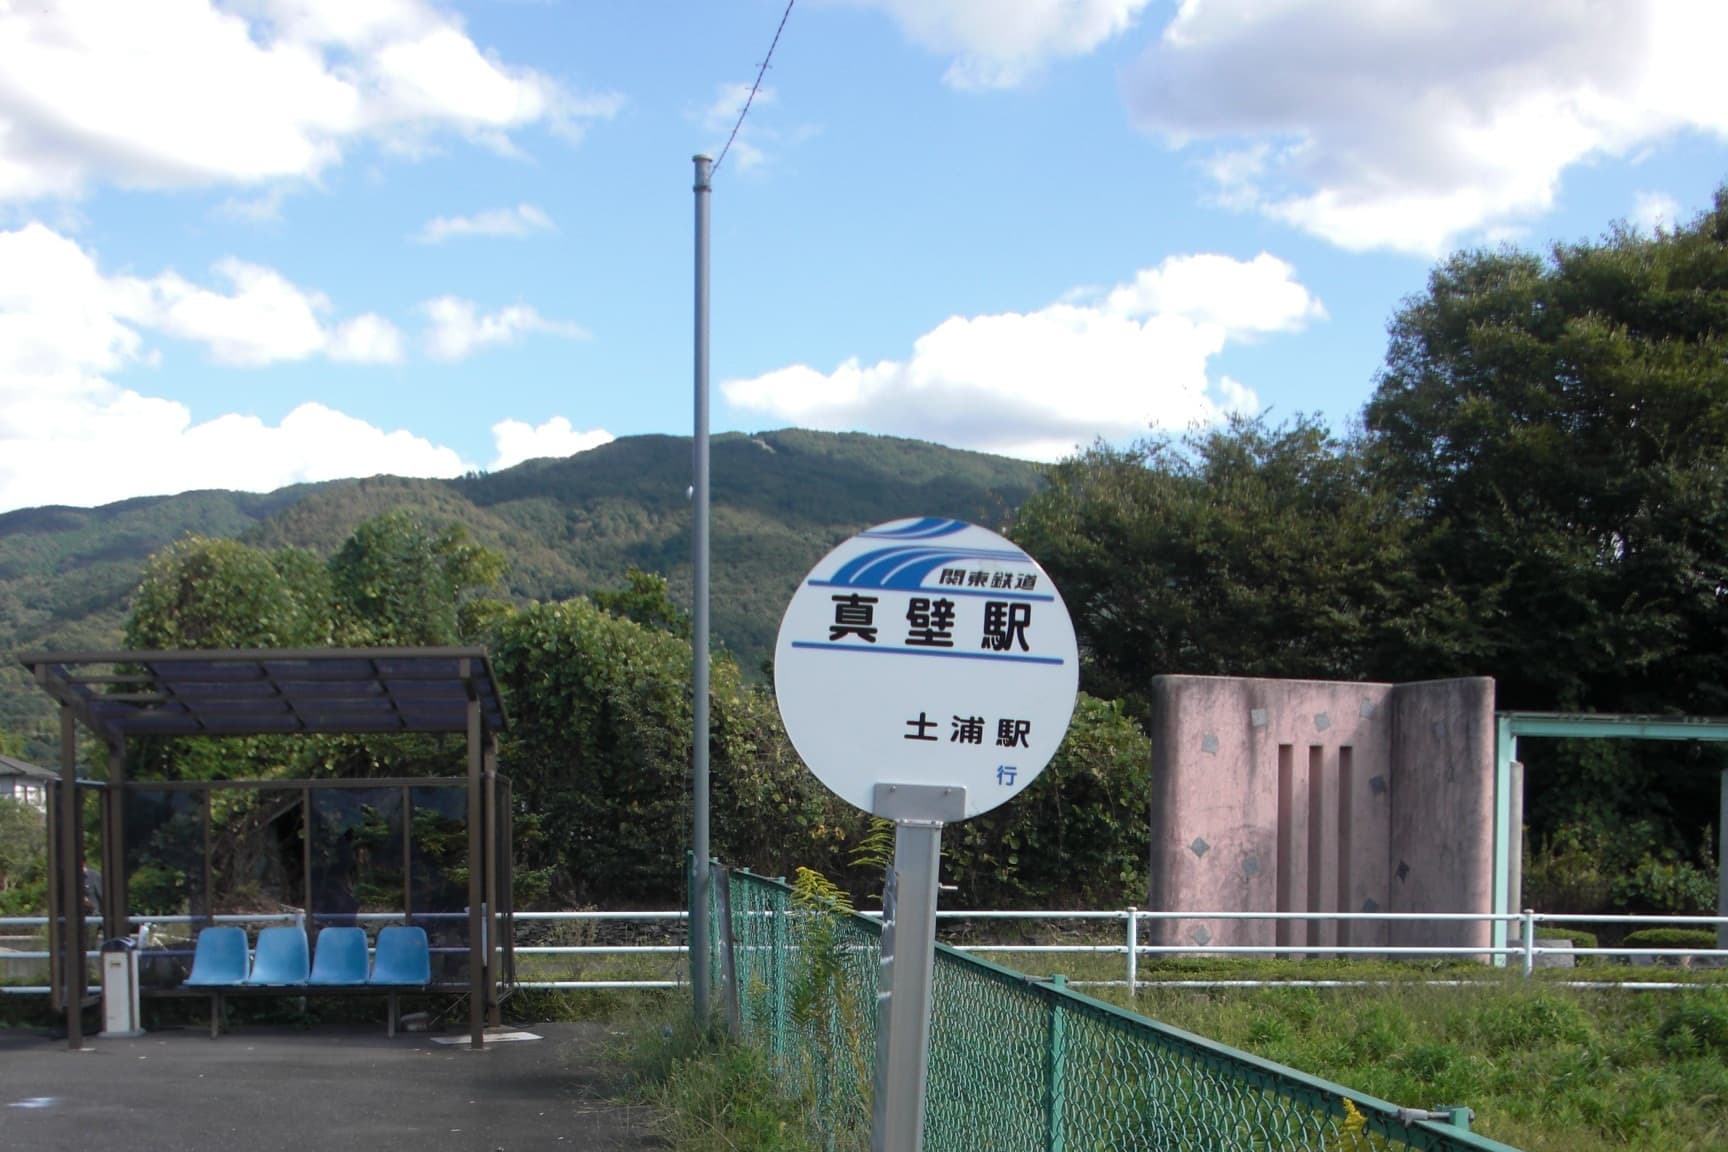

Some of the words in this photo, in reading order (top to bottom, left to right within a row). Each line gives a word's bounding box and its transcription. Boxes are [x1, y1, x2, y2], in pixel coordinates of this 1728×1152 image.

[939, 568, 1038, 591] 関東鉄道
[829, 593, 1032, 651] 真壁駅
[904, 712, 1031, 748] 土浦駅
[996, 765, 1017, 786] 行
